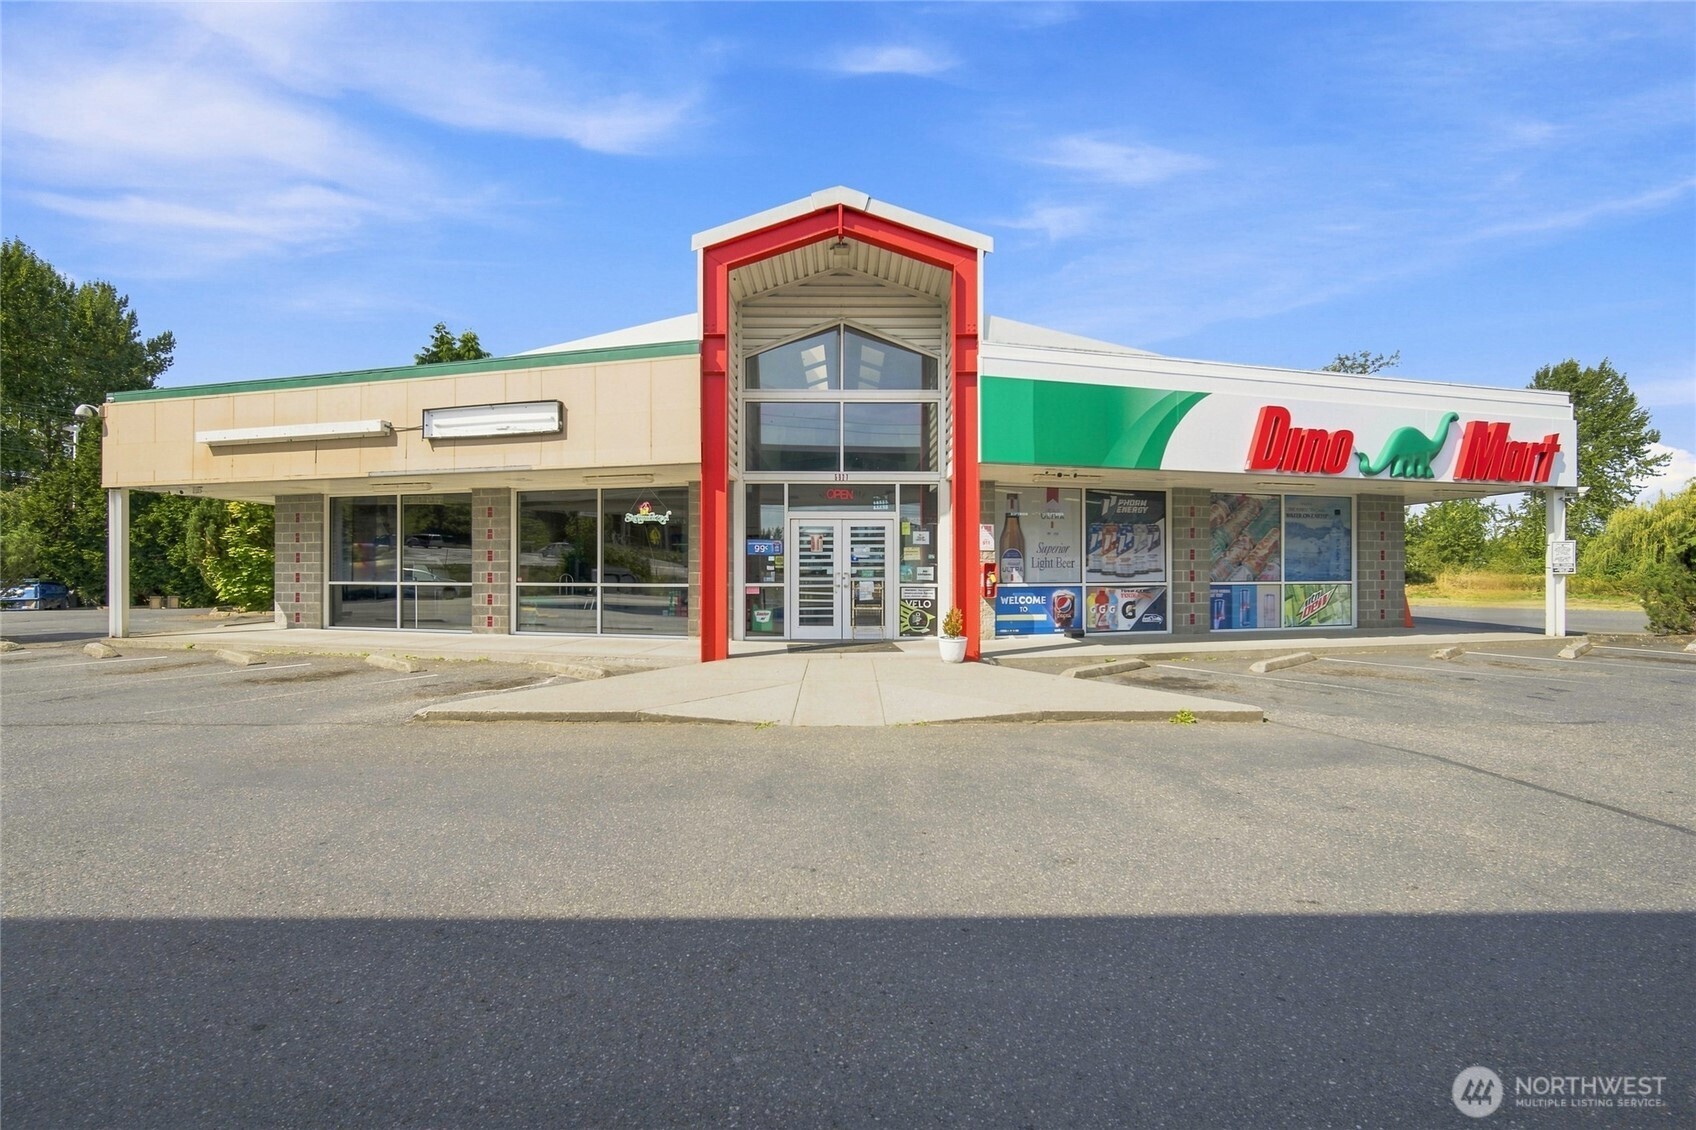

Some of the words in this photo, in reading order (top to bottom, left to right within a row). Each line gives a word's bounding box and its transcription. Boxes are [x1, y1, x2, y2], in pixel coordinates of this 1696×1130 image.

[1246, 405, 1354, 475] Dino
[1454, 420, 1561, 483] Mart
[826, 488, 854, 500] OPEN
[1116, 506, 1149, 514] ENERGY
[1036, 541, 1071, 554] Superior
[1031, 556, 1053, 571] Light
[1056, 556, 1076, 569] Beer
[905, 599, 932, 609] VELO
[1000, 595, 1047, 605] WELCOME
[1099, 605, 1106, 614] G
[1109, 605, 1116, 614] G
[1121, 600, 1137, 620] G
